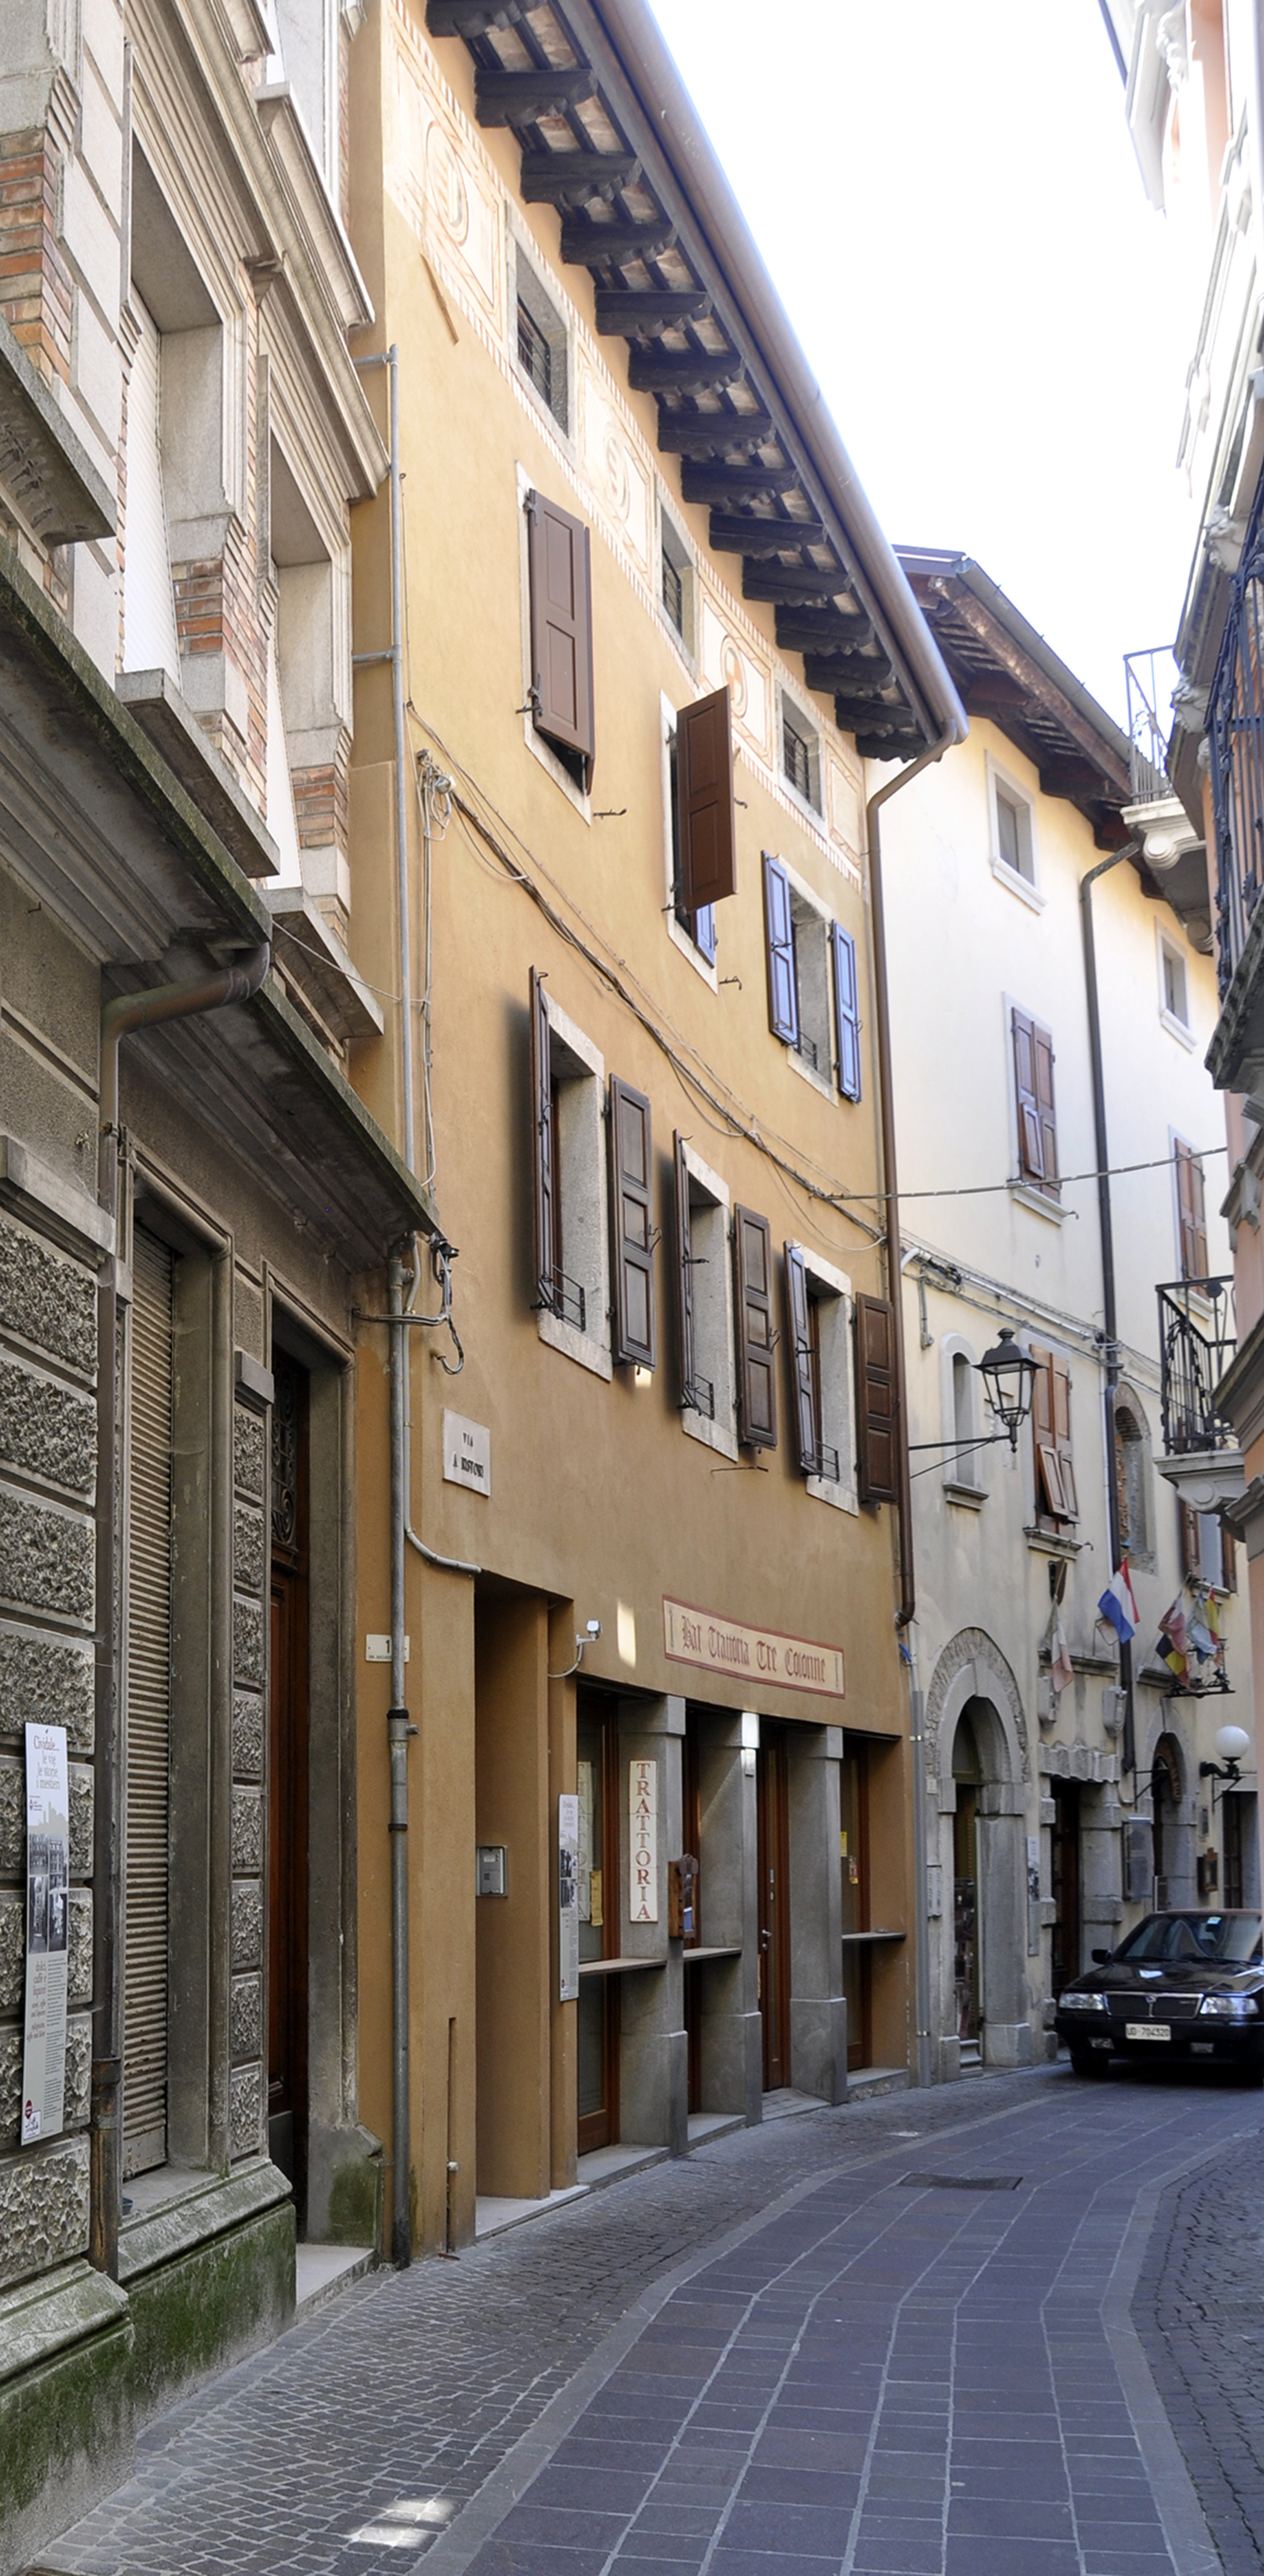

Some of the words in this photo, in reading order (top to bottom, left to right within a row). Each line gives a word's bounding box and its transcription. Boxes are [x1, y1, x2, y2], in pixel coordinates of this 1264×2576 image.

[462, 1432, 474, 1447] VIA
[461, 1456, 484, 1478] RISTORI
[681, 1615, 702, 1653] Bar
[707, 1625, 750, 1665] Trattoria
[756, 1640, 778, 1673] Tre
[784, 1648, 827, 1683] Colonne
[636, 1763, 652, 1920] TRATTORIA
